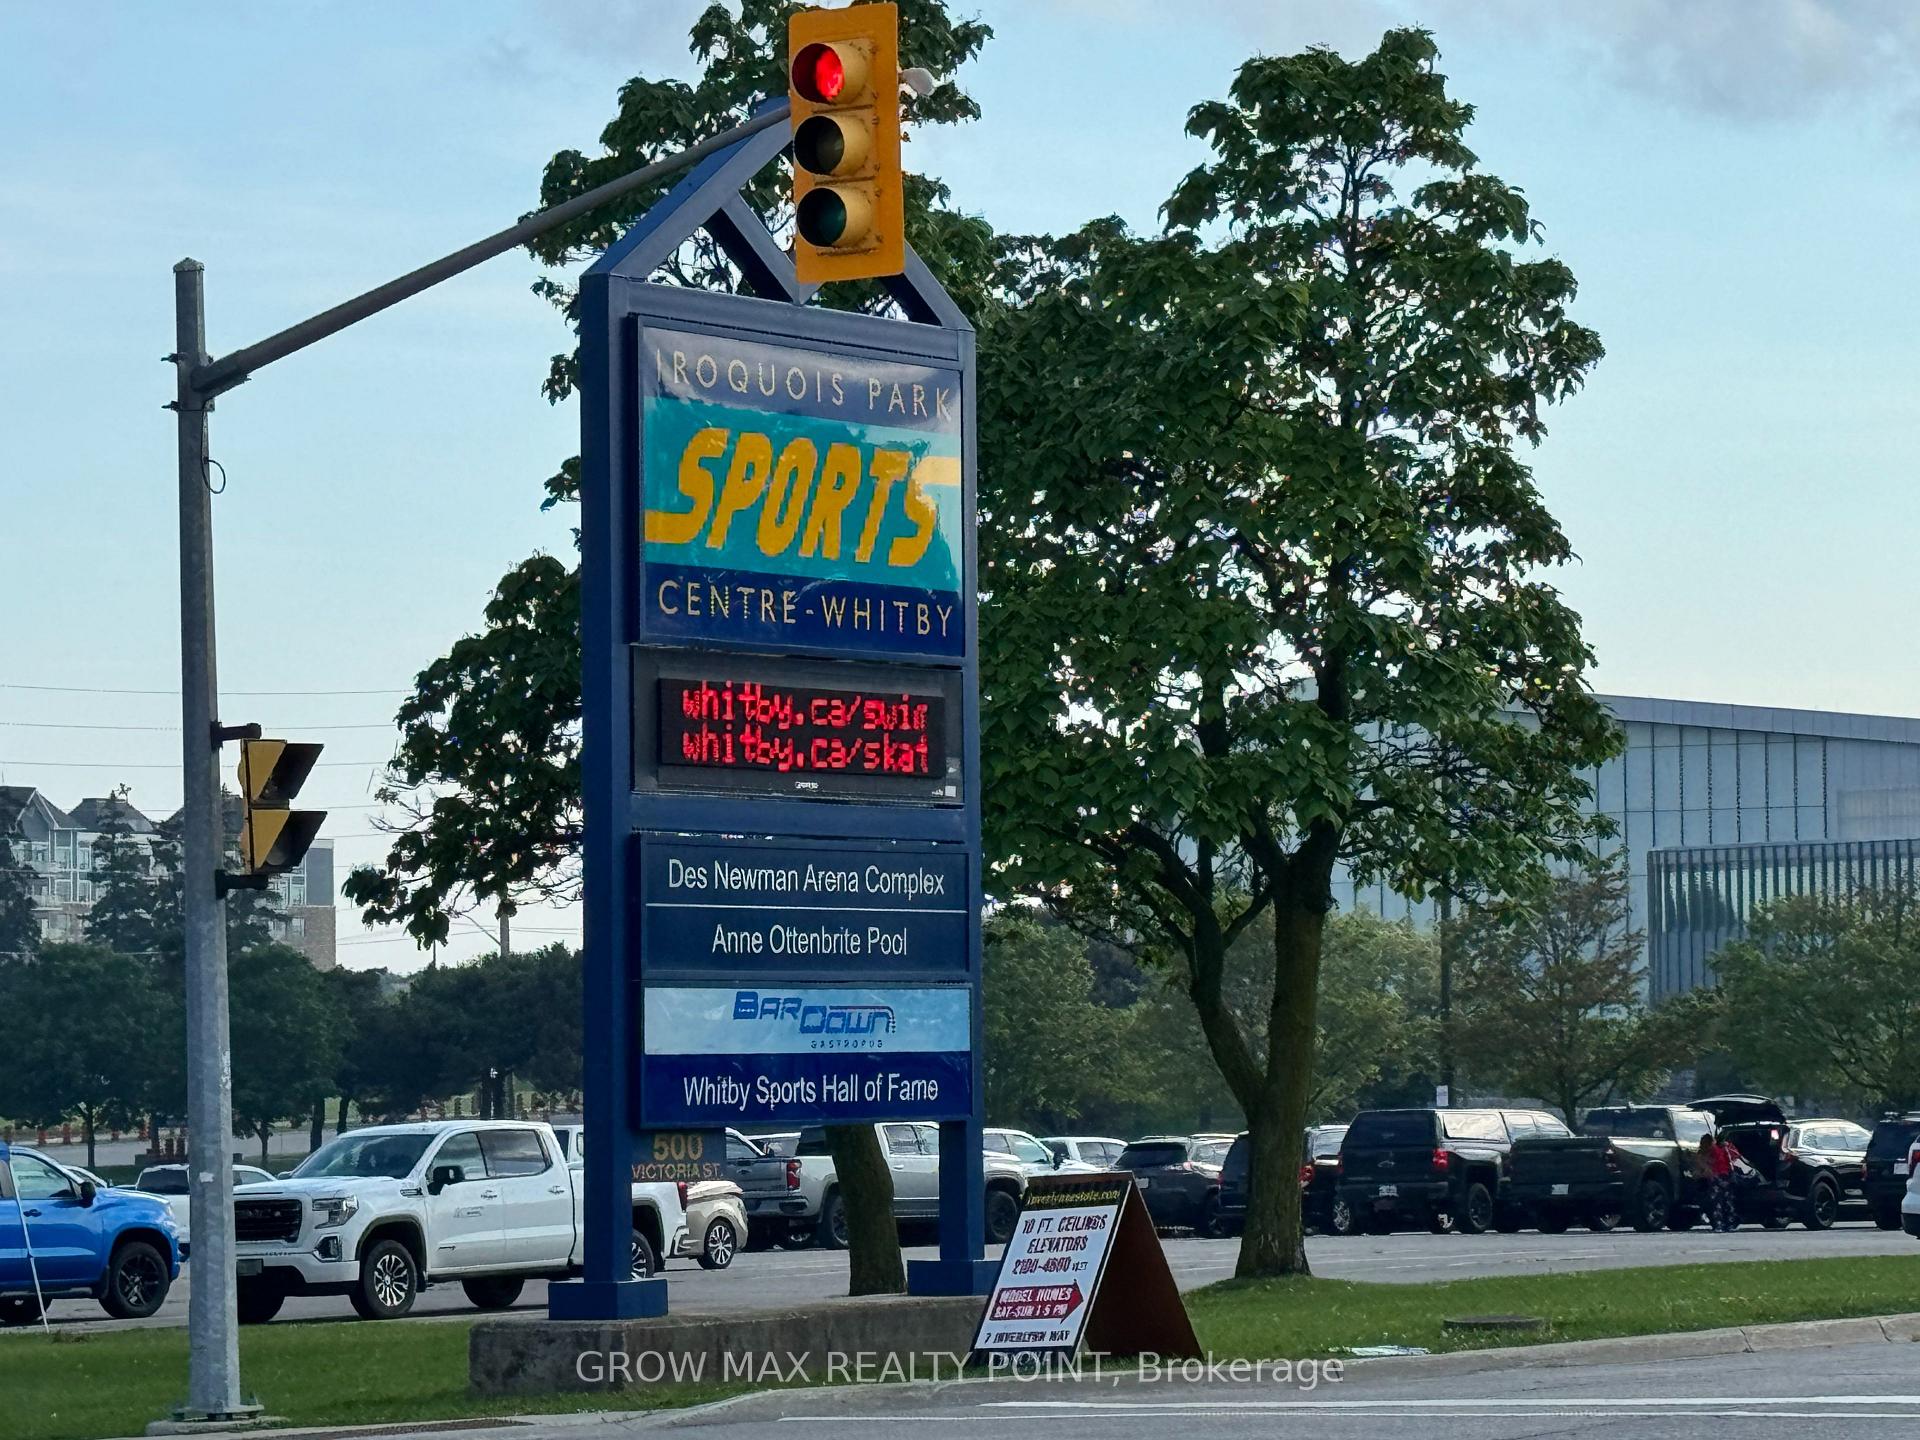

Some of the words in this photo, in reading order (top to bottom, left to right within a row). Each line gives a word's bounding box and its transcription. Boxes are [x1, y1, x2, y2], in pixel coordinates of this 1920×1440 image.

[656, 348, 844, 406] IROQUOIS
[868, 377, 952, 421] PARK
[645, 428, 961, 567] SPORTS
[668, 859, 708, 889] Des
[714, 860, 799, 891] Newman
[803, 864, 859, 893] Arena
[865, 865, 945, 900] Complex
[712, 924, 763, 953] Anne
[770, 924, 861, 955] Ottenbrite
[867, 927, 908, 955] Pool
[684, 1076, 750, 1111] Whitby
[756, 1075, 816, 1110] Sports
[822, 1074, 859, 1103] Hall
[864, 1073, 884, 1101] of
[888, 1073, 939, 1102] Fame
[653, 1134, 703, 1160] 500
[632, 1163, 700, 1179] VICTORIA
[1027, 1235, 1088, 1254] ELEVATORS
[999, 1289, 1033, 1303] MODEL
